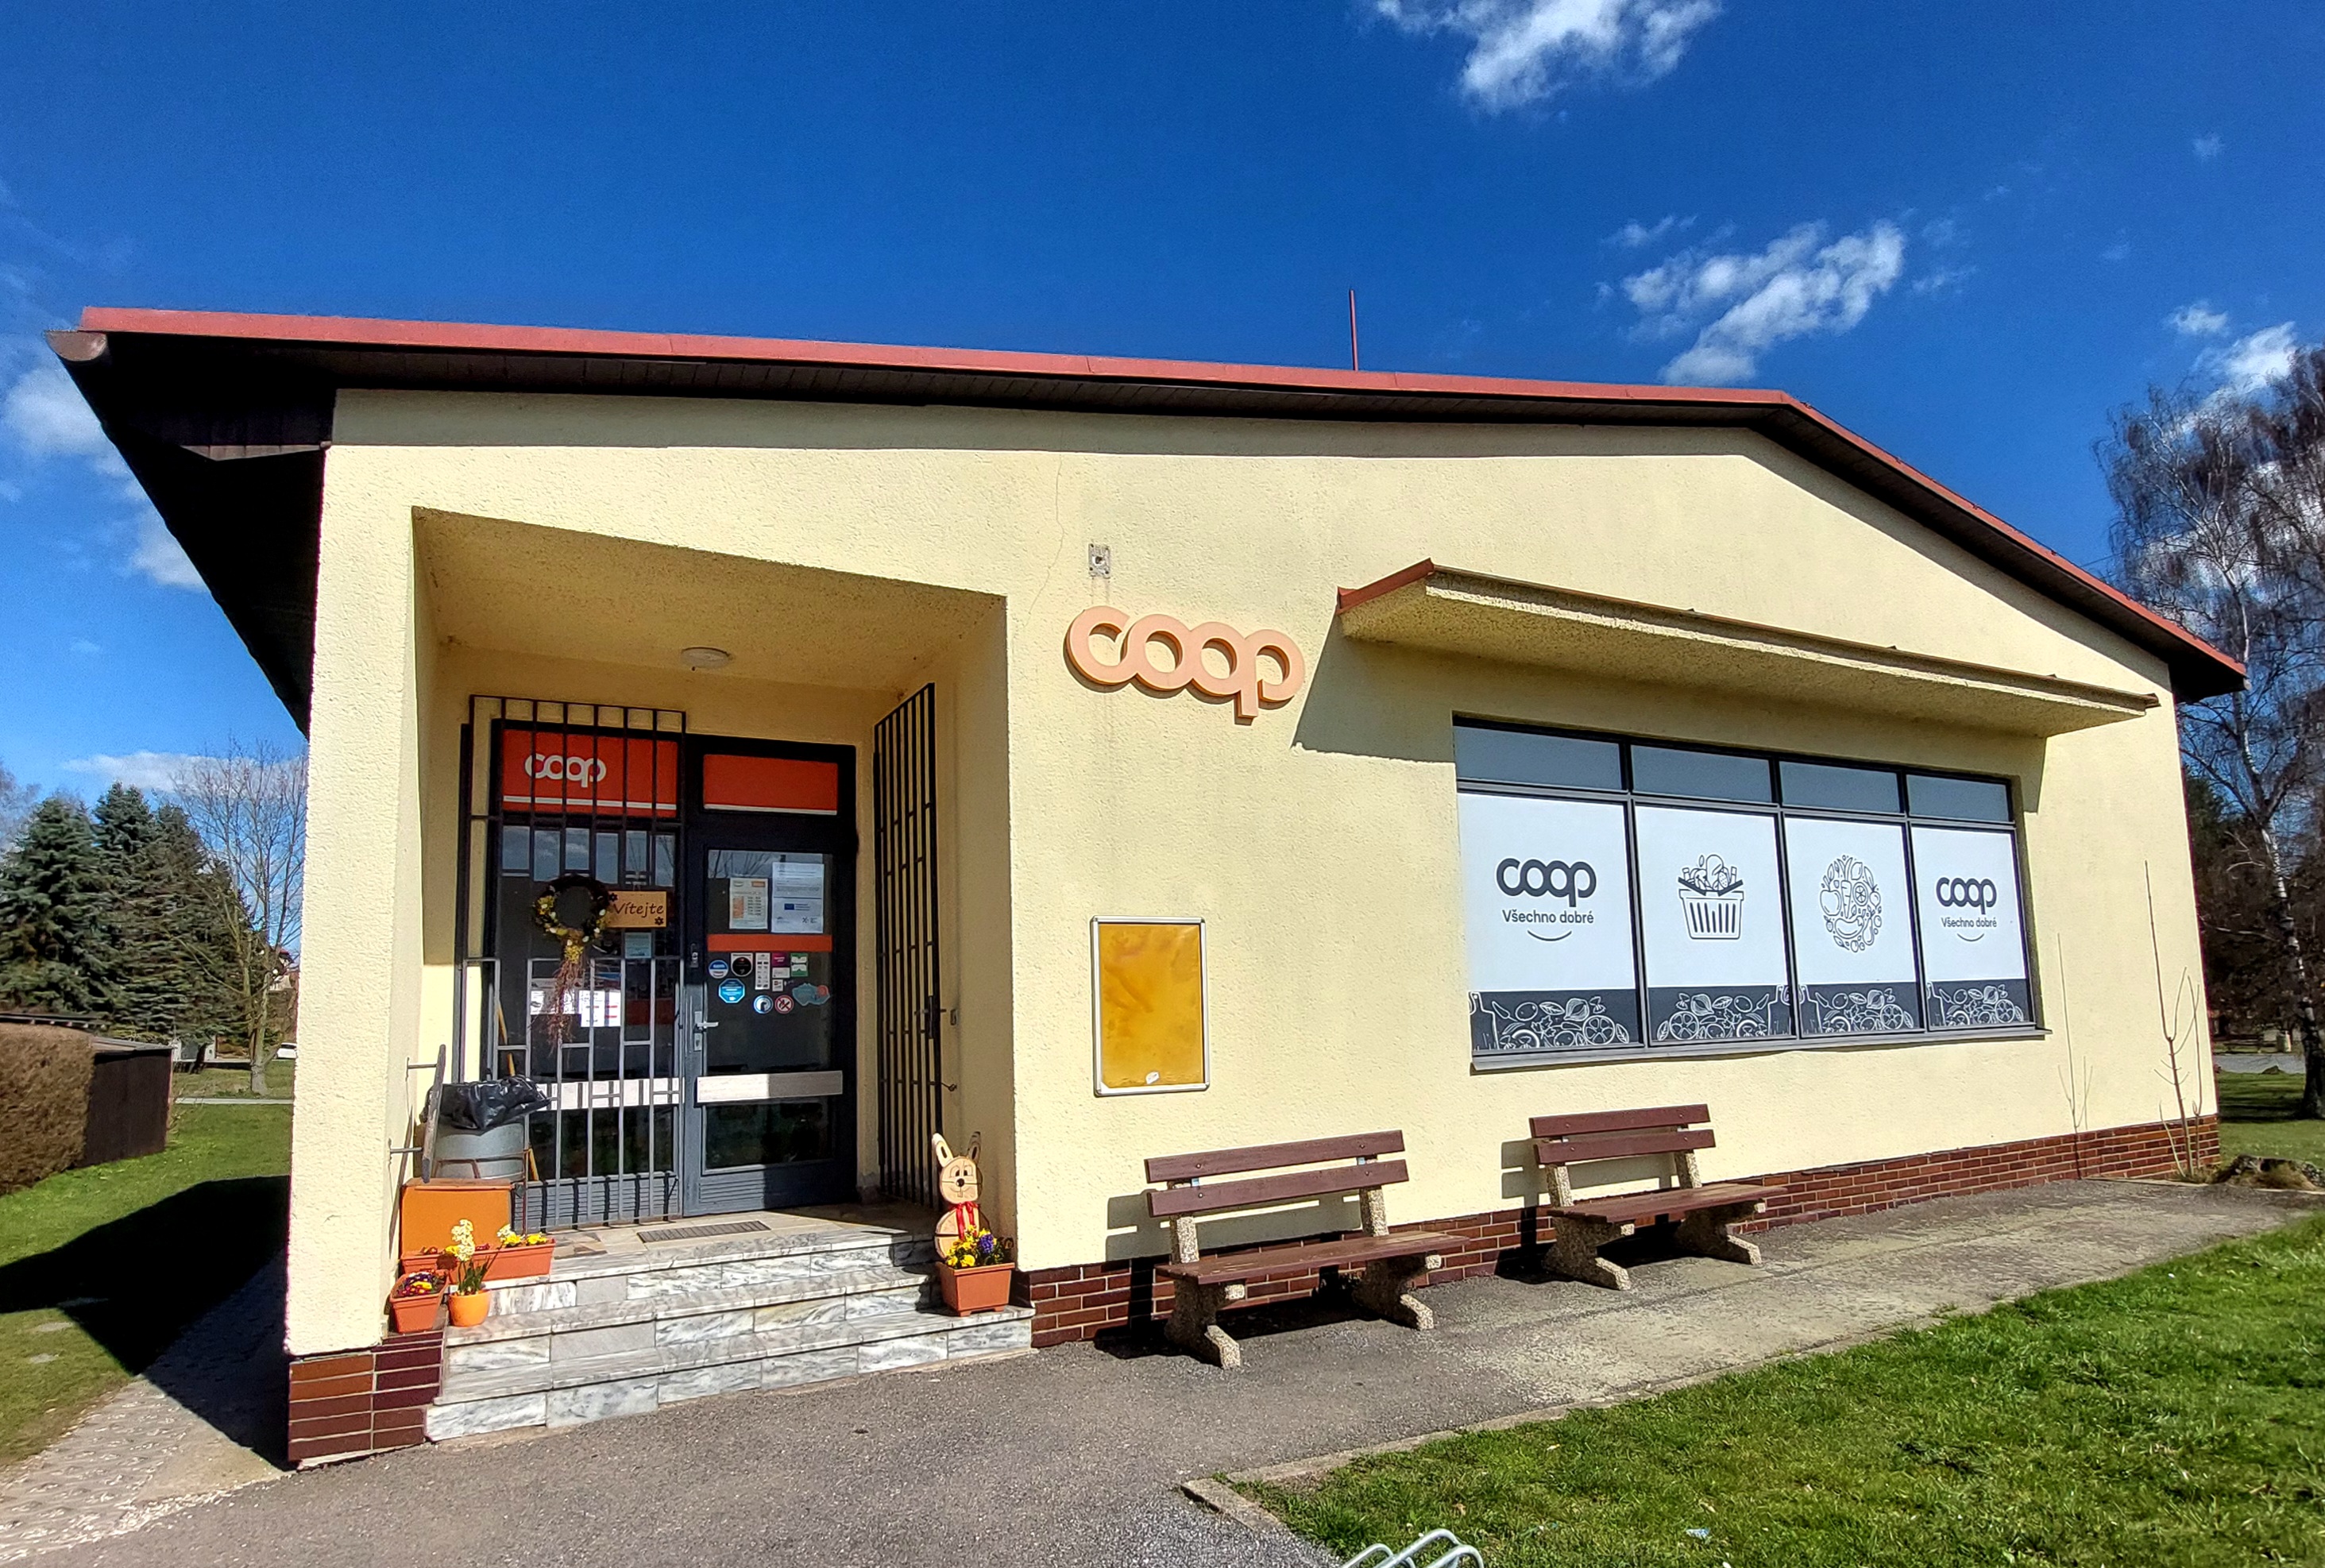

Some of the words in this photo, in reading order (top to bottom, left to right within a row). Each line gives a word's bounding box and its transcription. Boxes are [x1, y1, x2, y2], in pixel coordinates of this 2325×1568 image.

[1066, 605, 1305, 720] coop
[525, 753, 606, 787] coop
[1497, 858, 1597, 907] coop
[1936, 877, 1997, 915] coop
[613, 902, 664, 918] Vítejte
[1502, 909, 1556, 923] Všechno
[1559, 910, 1594, 923] dobré
[1941, 917, 1974, 928] Všechno
[1975, 917, 1997, 928] dobré
